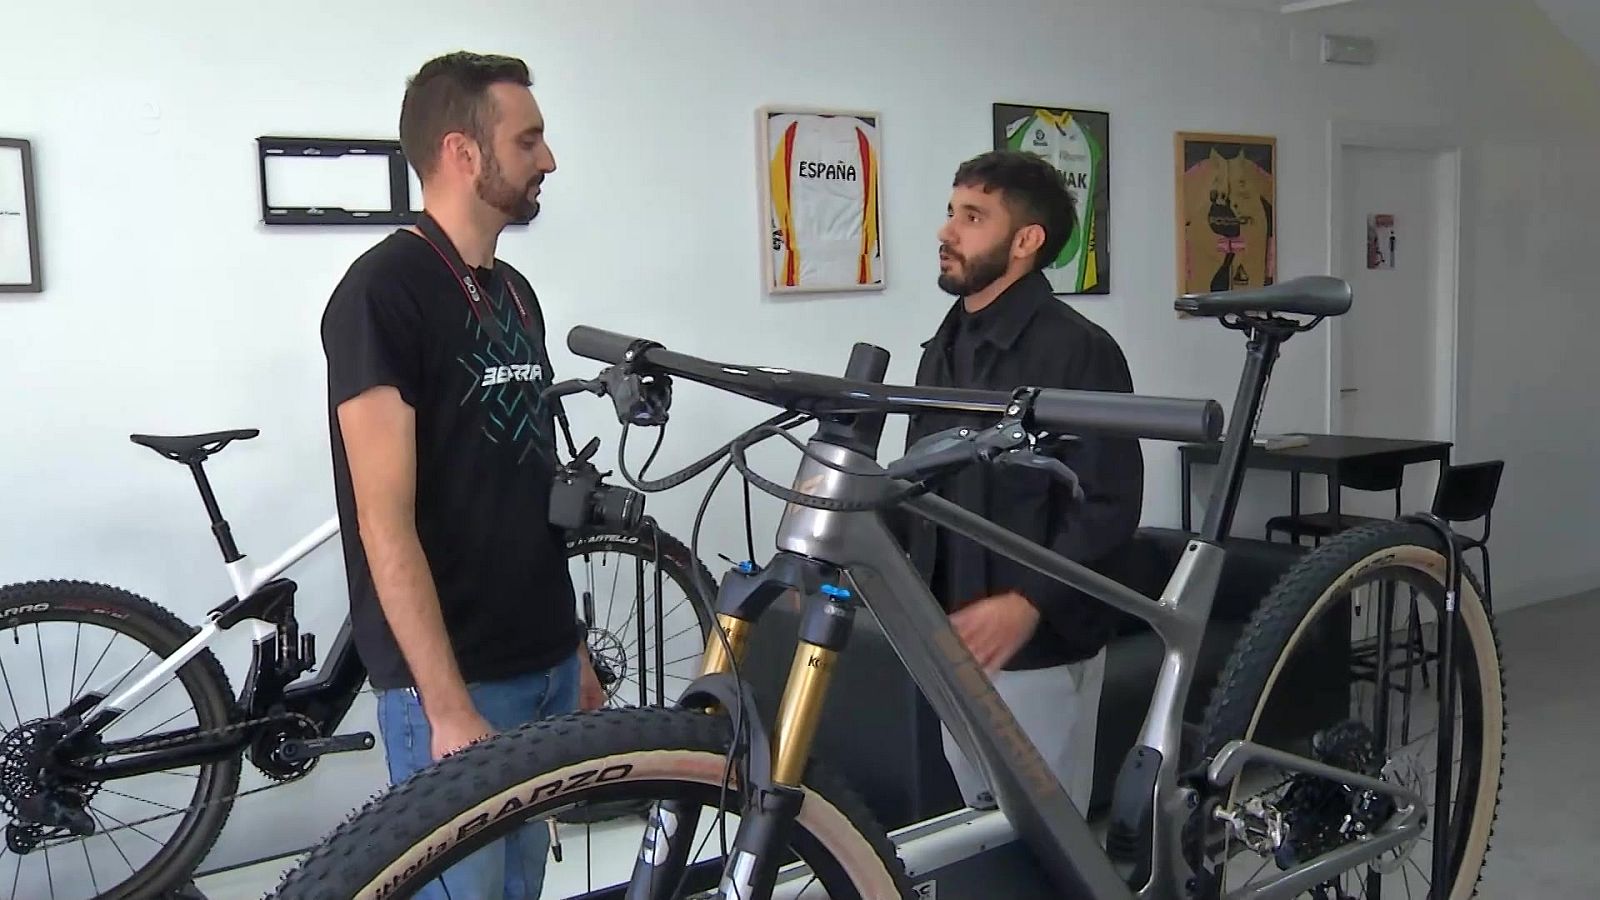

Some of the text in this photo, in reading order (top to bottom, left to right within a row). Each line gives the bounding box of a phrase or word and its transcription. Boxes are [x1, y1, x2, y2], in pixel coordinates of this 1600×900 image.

[799, 160, 857, 182] ESPAÑA
[375, 840, 449, 900] ittoria
[456, 764, 634, 842] BARZO
